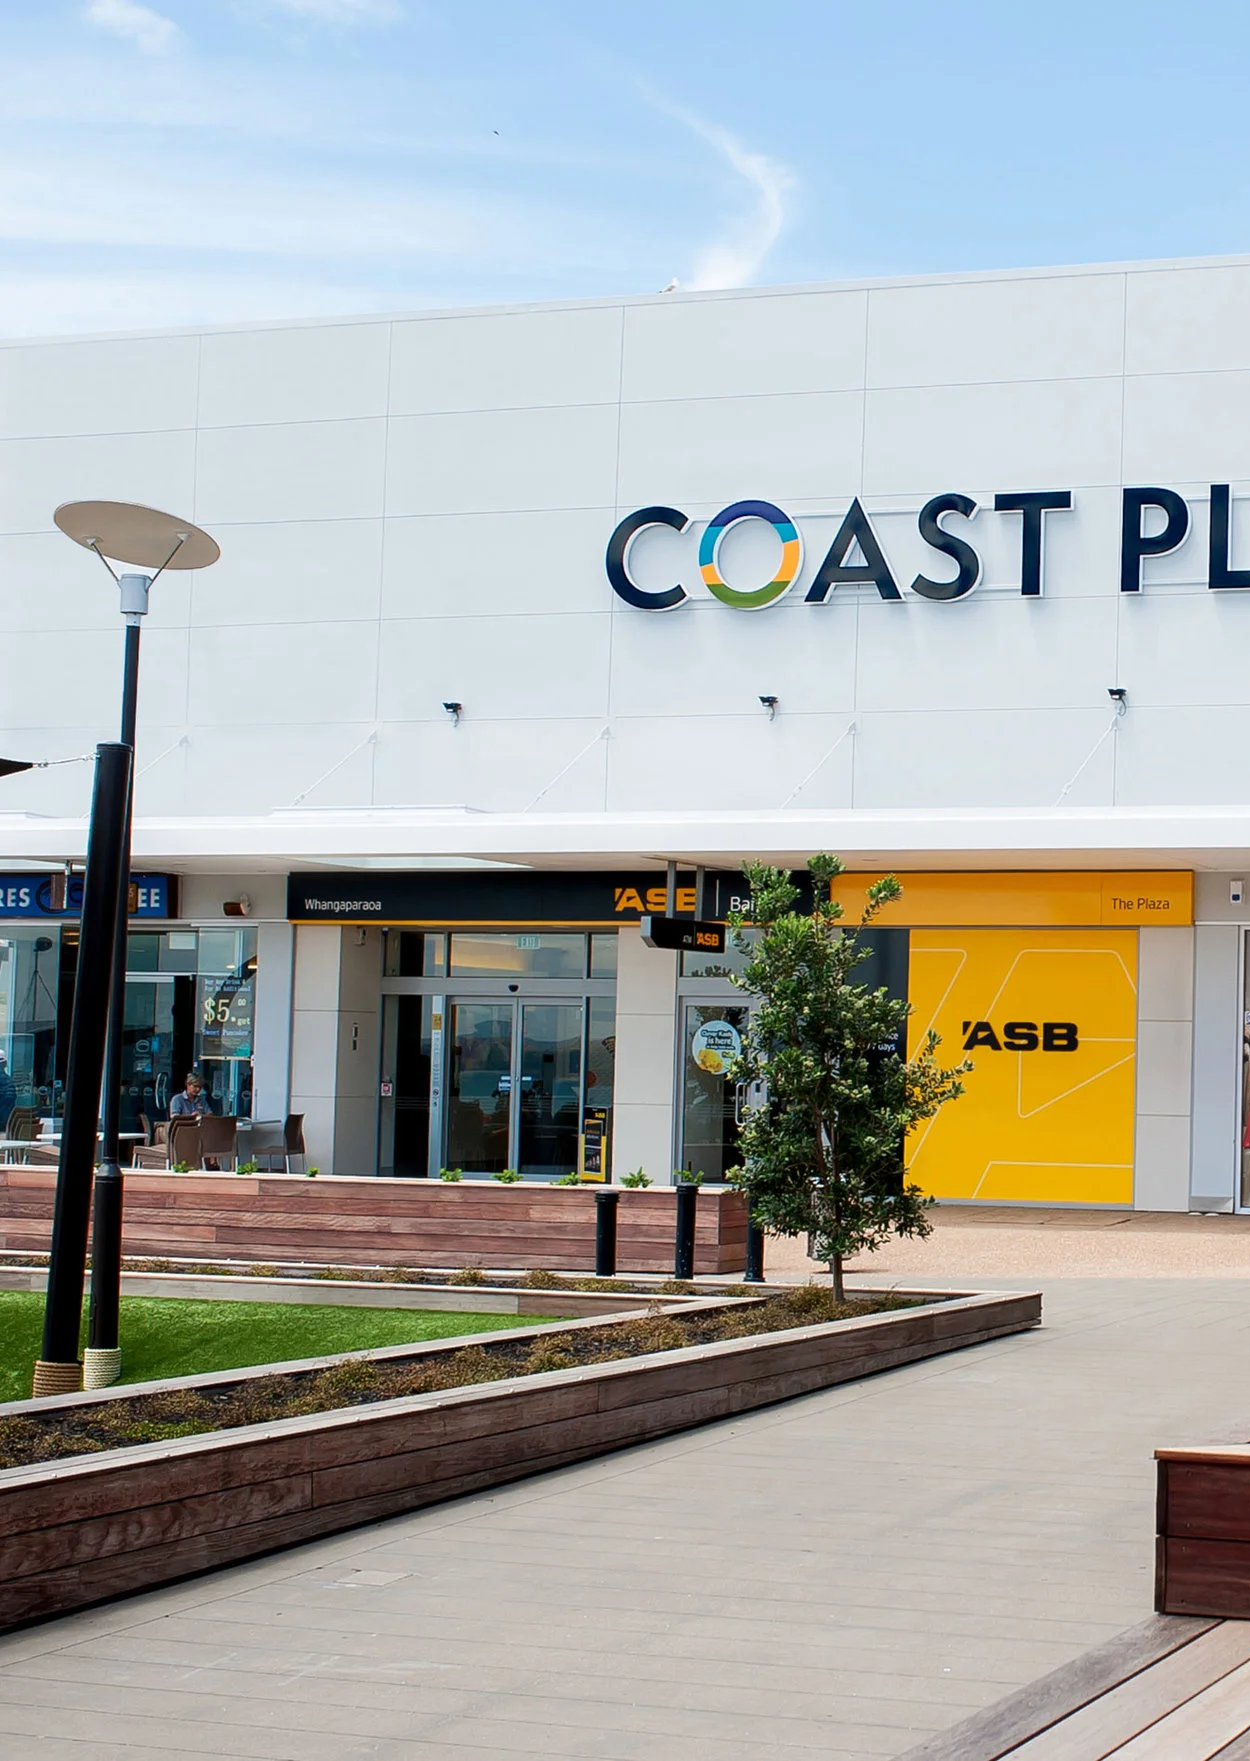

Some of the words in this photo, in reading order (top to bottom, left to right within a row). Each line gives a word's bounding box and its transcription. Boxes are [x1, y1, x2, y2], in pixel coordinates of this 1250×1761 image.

[605, 490, 1072, 612] COAST
[304, 898, 382, 913] Whangaparaoa
[1112, 897, 1134, 910] The
[1137, 897, 1170, 910] Plaza
[696, 932, 719, 947] ASB
[962, 1021, 1079, 1052] ASB
